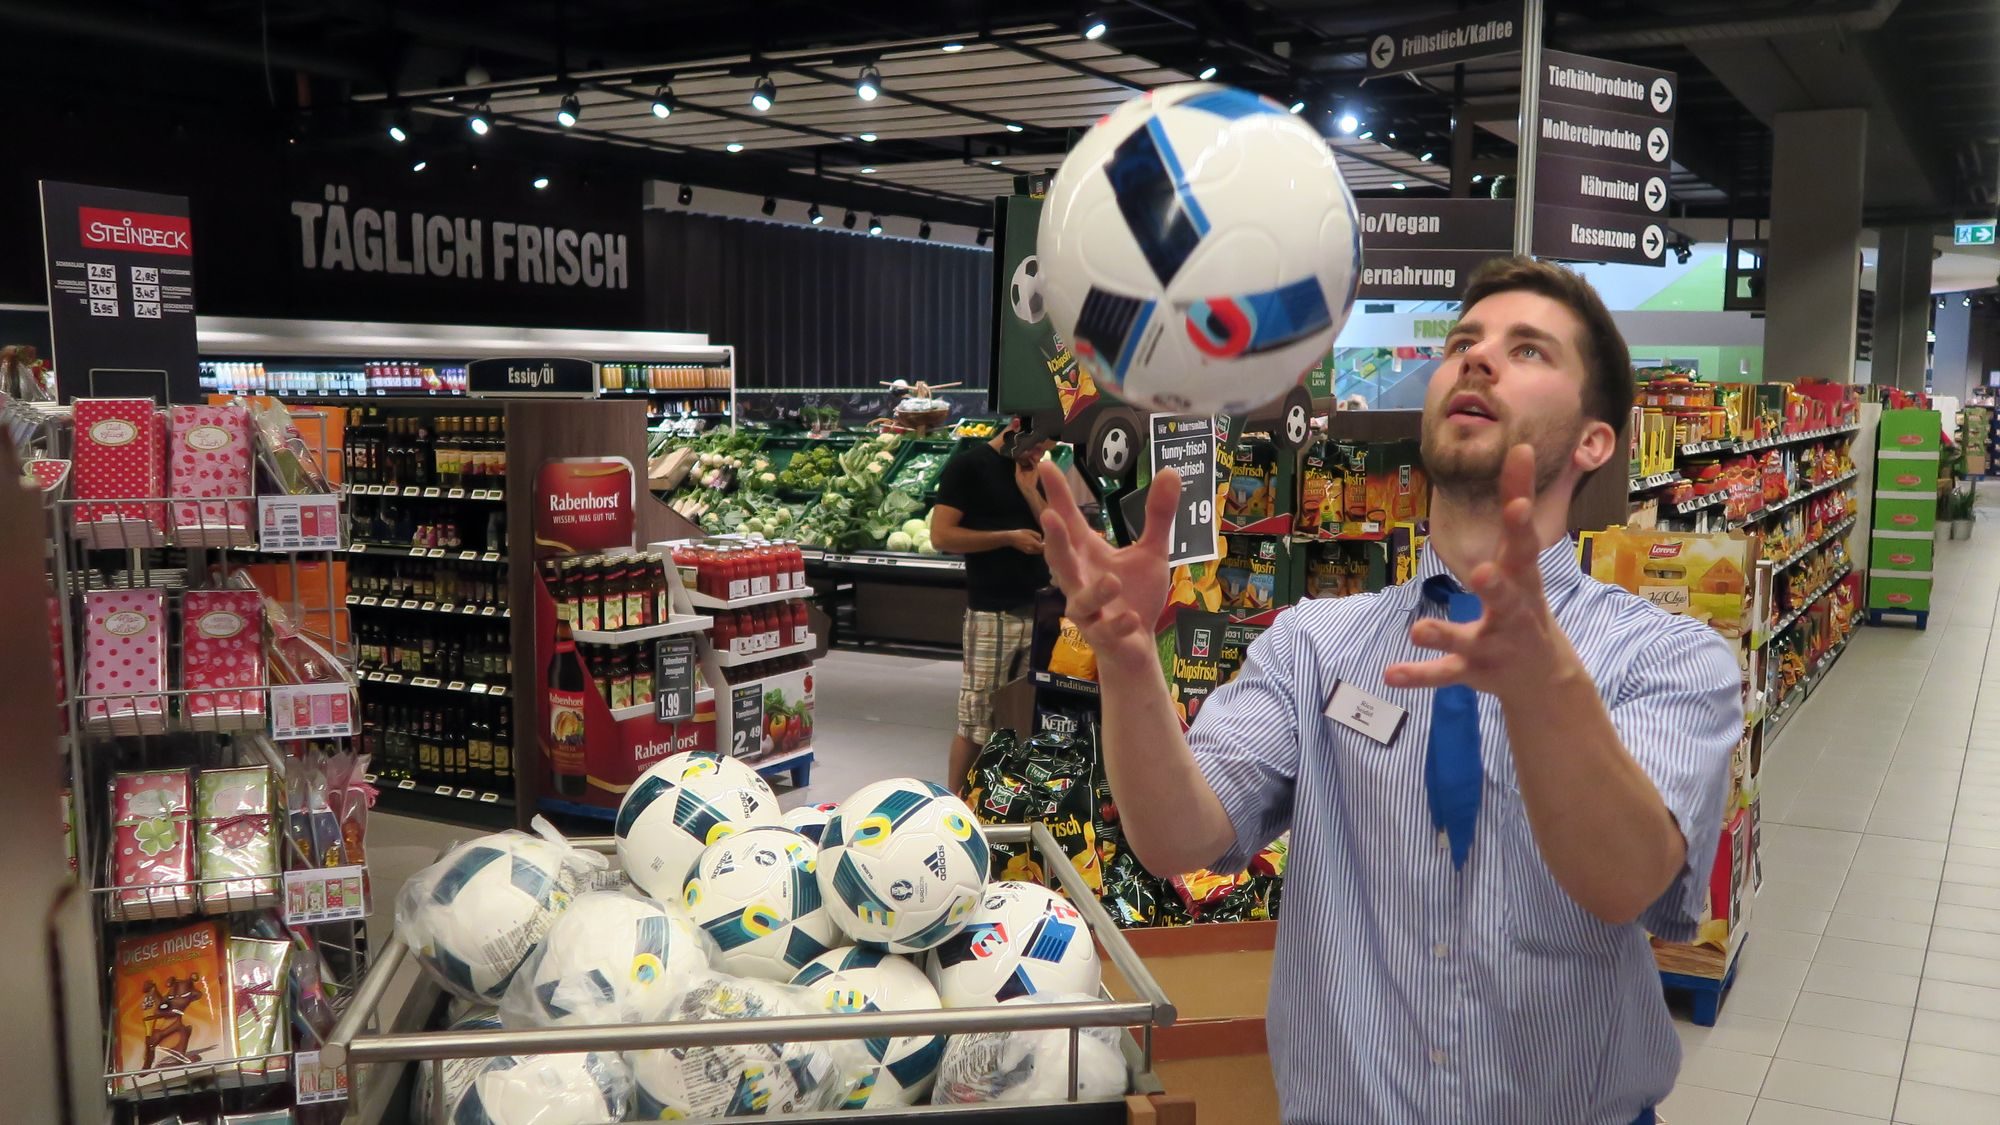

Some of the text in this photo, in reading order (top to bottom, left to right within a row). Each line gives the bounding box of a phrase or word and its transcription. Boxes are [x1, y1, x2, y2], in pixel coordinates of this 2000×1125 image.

[1402, 21, 1512, 57] Frühstück/Kaffee
[1549, 65, 1645, 100] Tiefkühlprodukte
[1543, 118, 1641, 151] Molkereiprodukte
[1581, 175, 1639, 201] Nährmittel
[291, 184, 629, 289] TÄGLICH FRISCH
[1360, 213, 1440, 235] io/Vegan
[1571, 224, 1636, 249] Kassenzone
[1360, 266, 1456, 288] ernahrung
[508, 363, 554, 387] Essig/Öl
[1161, 440, 1207, 461] funny-frisch
[550, 491, 619, 511] Rabenhorst
[579, 514, 592, 522] WAS
[593, 513, 604, 521] GUT
[1055, 679, 1099, 694] traditional
[660, 692, 680, 717] 1.99
[1041, 714, 1078, 733] KETTLE
[711, 851, 730, 879] adidas
[938, 845, 947, 881] adidas
